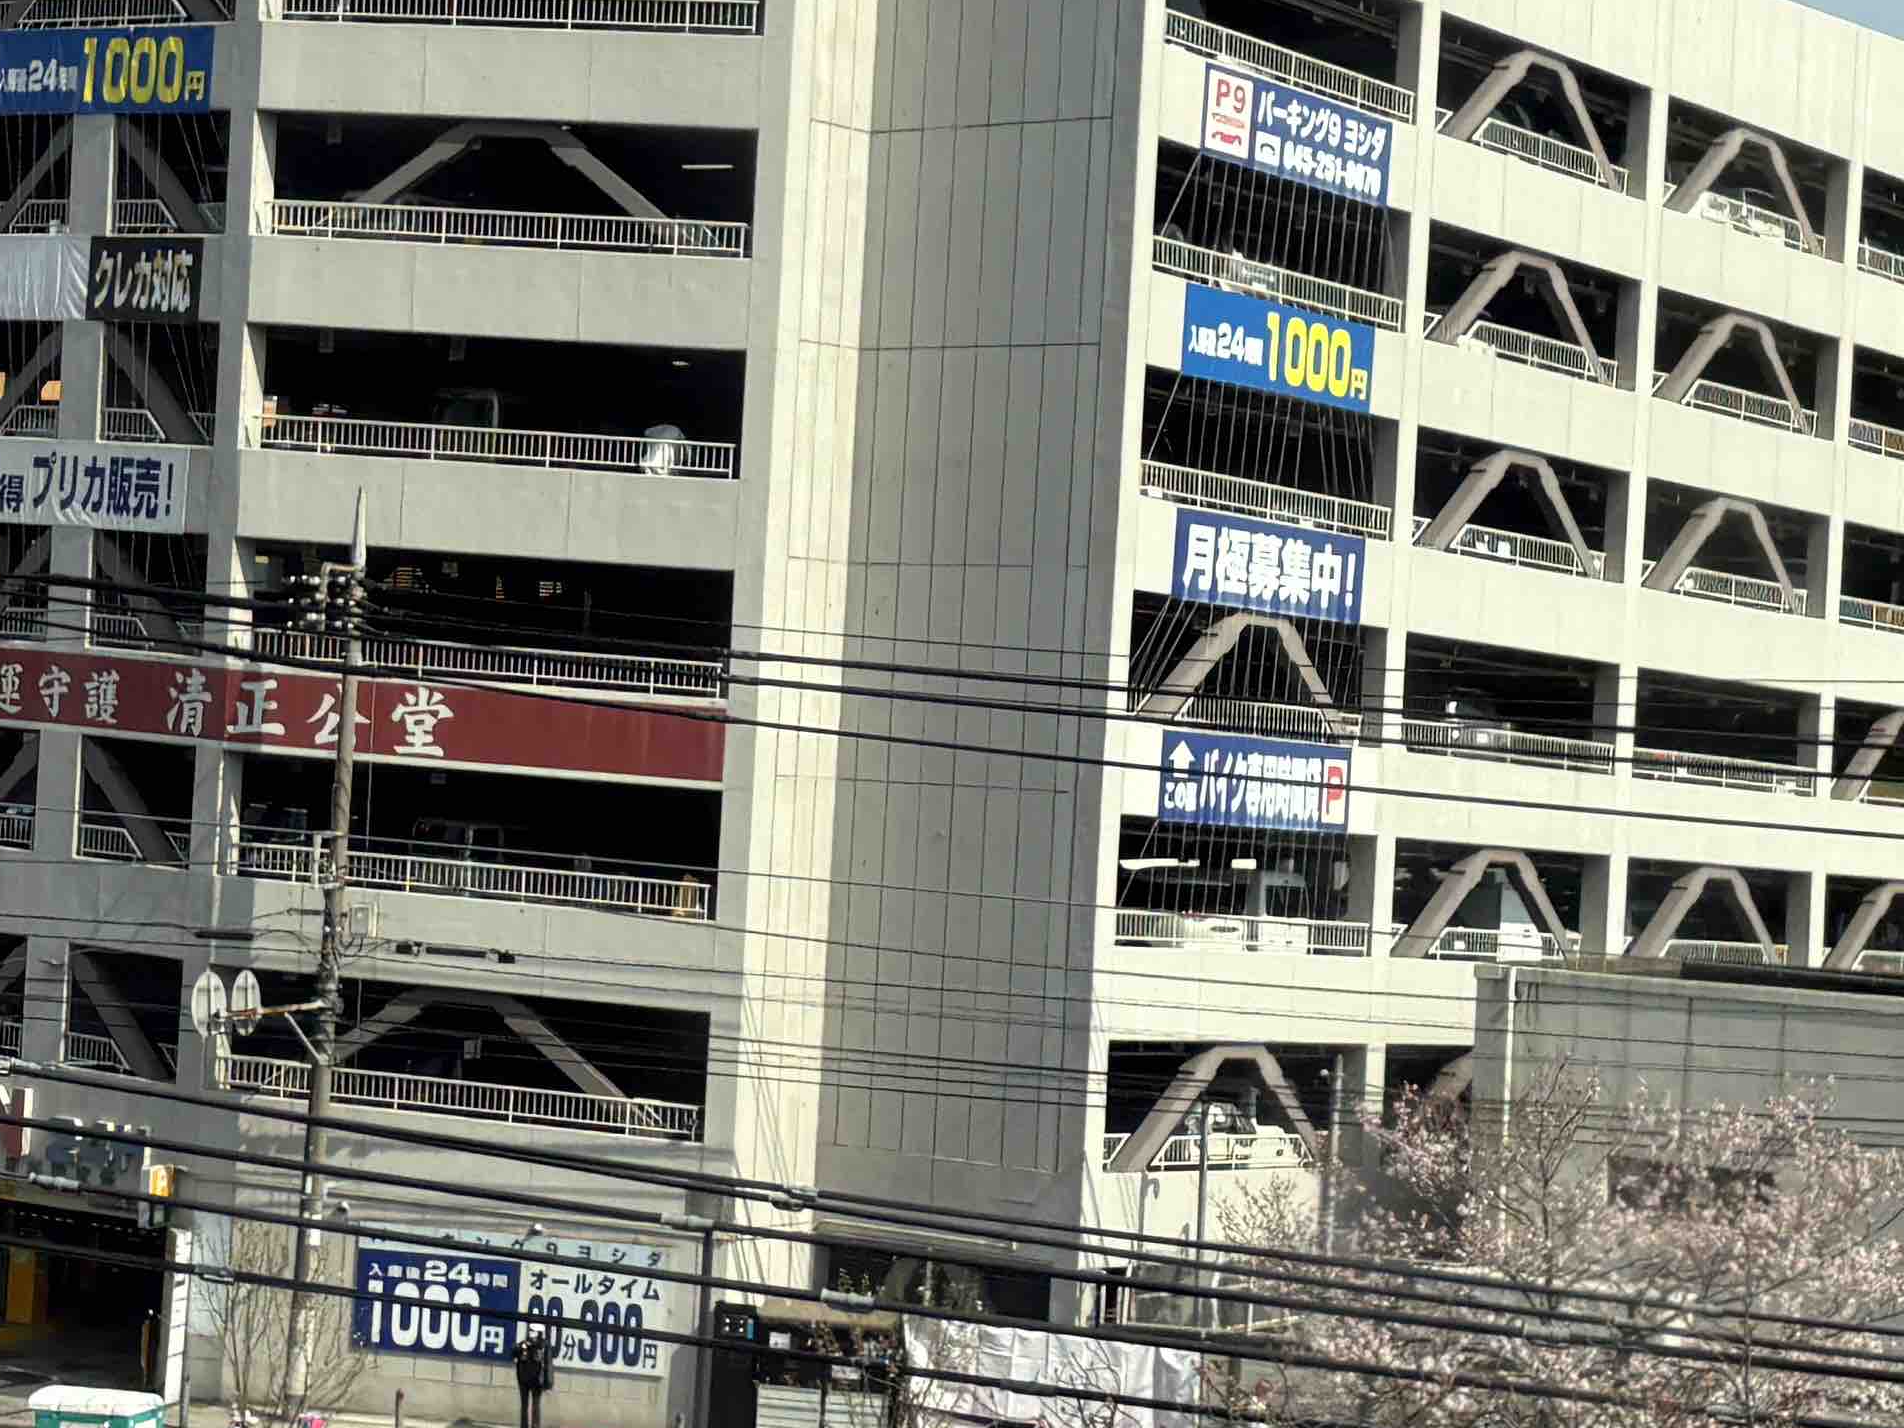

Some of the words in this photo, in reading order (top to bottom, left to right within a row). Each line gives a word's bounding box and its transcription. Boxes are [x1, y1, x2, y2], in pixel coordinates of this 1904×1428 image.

[82, 36, 206, 104] 1000円
[1215, 78, 1246, 114] P9
[95, 248, 192, 309] クレカ対応
[1267, 311, 1368, 400] 1000円
[165, 667, 455, 758] 清正公堂
[529, 1268, 662, 1302] オールタイム
